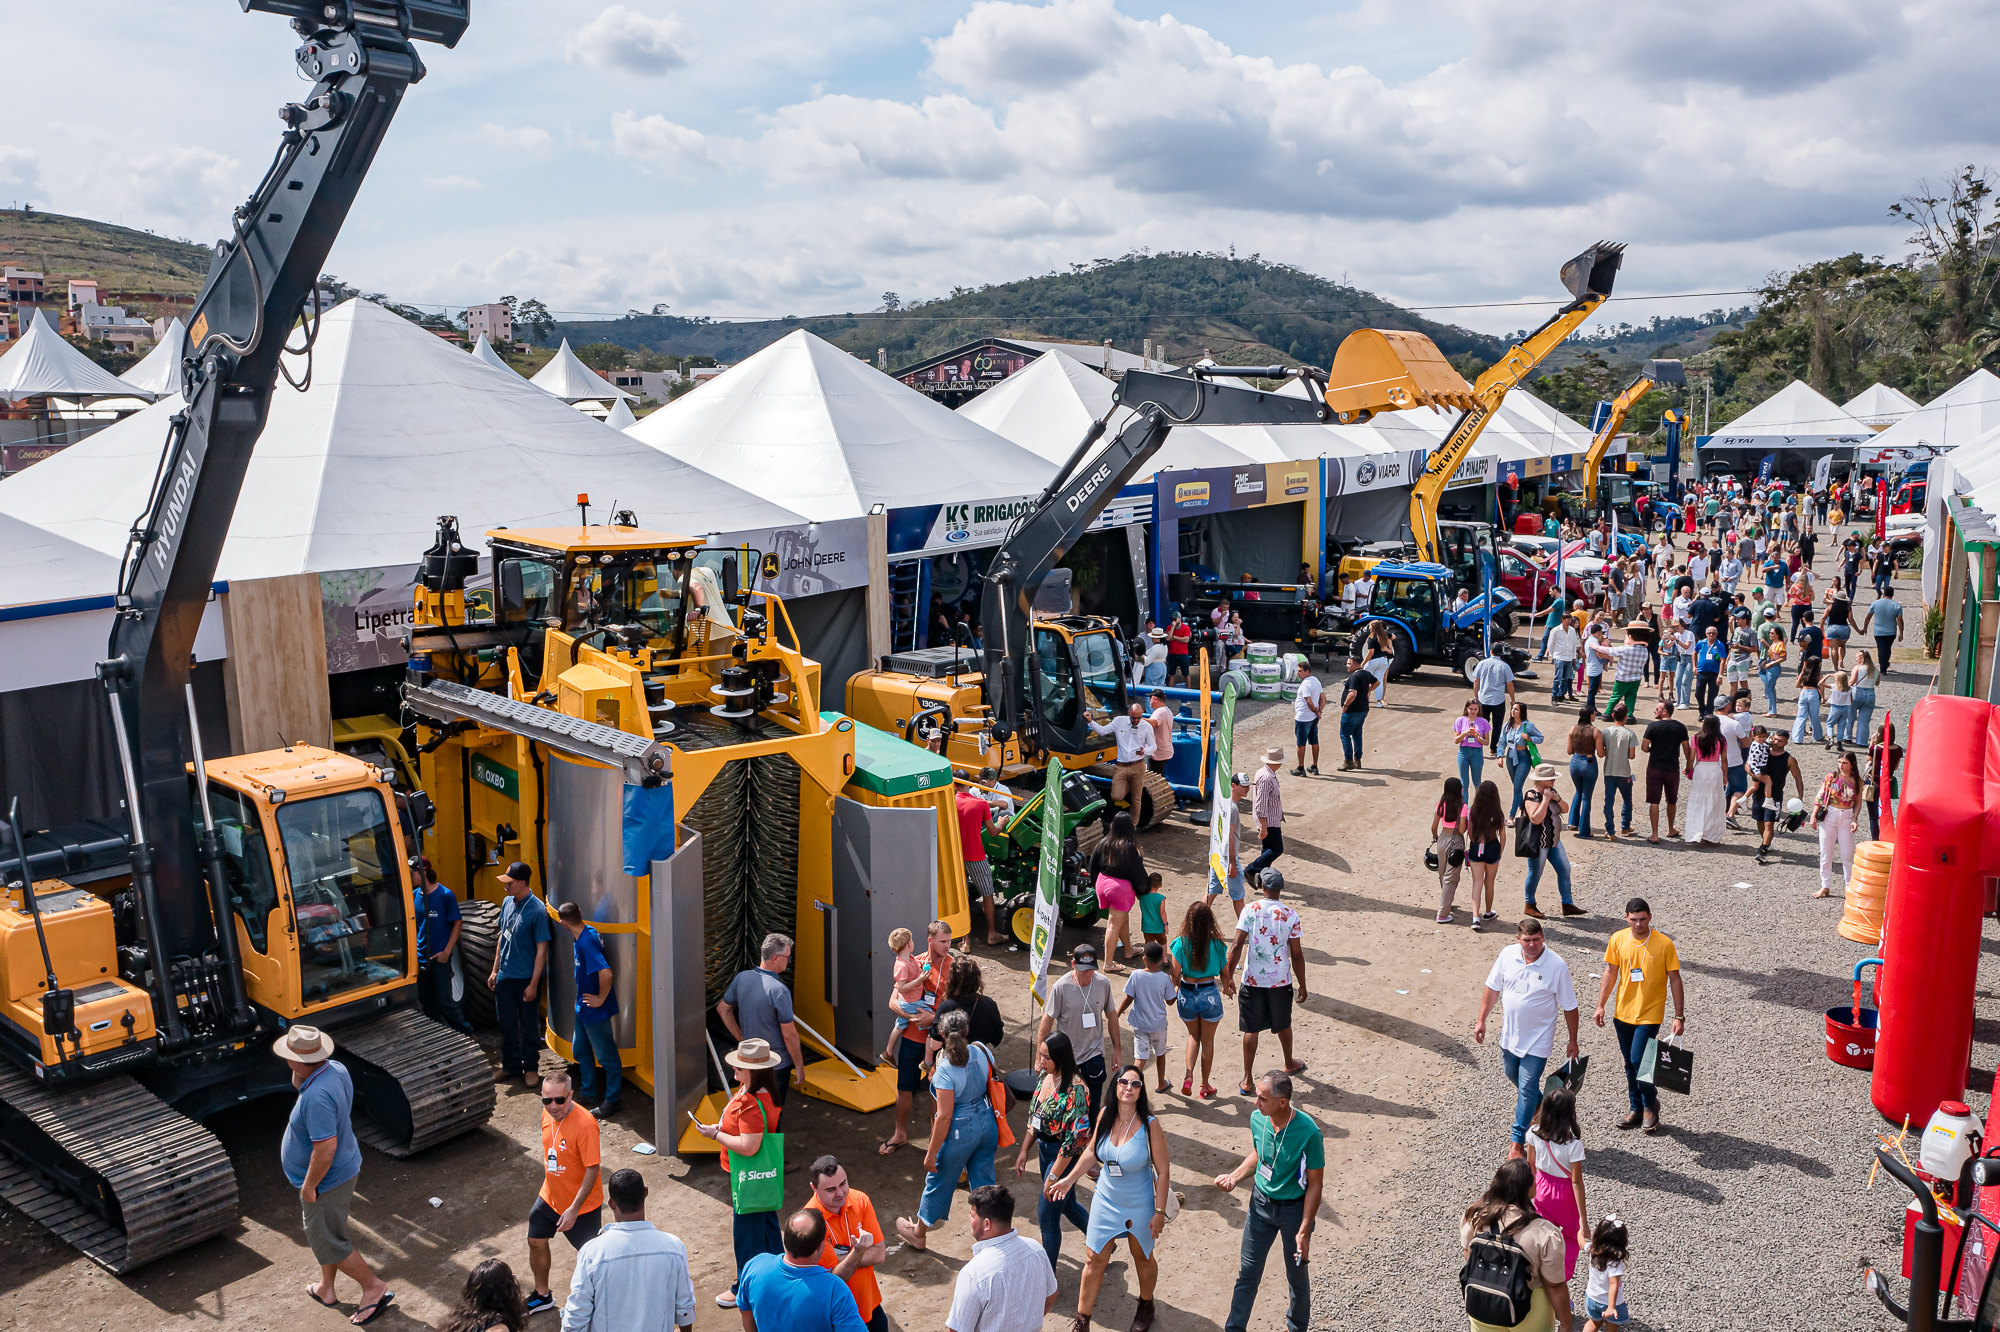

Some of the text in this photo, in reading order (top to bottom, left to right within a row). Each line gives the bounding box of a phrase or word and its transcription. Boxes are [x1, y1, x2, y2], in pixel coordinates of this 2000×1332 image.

[1434, 451, 1453, 475] NEW
[1450, 409, 1485, 453] HOLLAND
[1378, 463, 1401, 480] VIAFOR
[1065, 462, 1112, 513] DEERE
[154, 448, 197, 570] HYUNDAI
[784, 551, 846, 571] JOHN DEERE
[354, 608, 415, 635] Lipetra
[485, 769, 505, 789] OXBO
